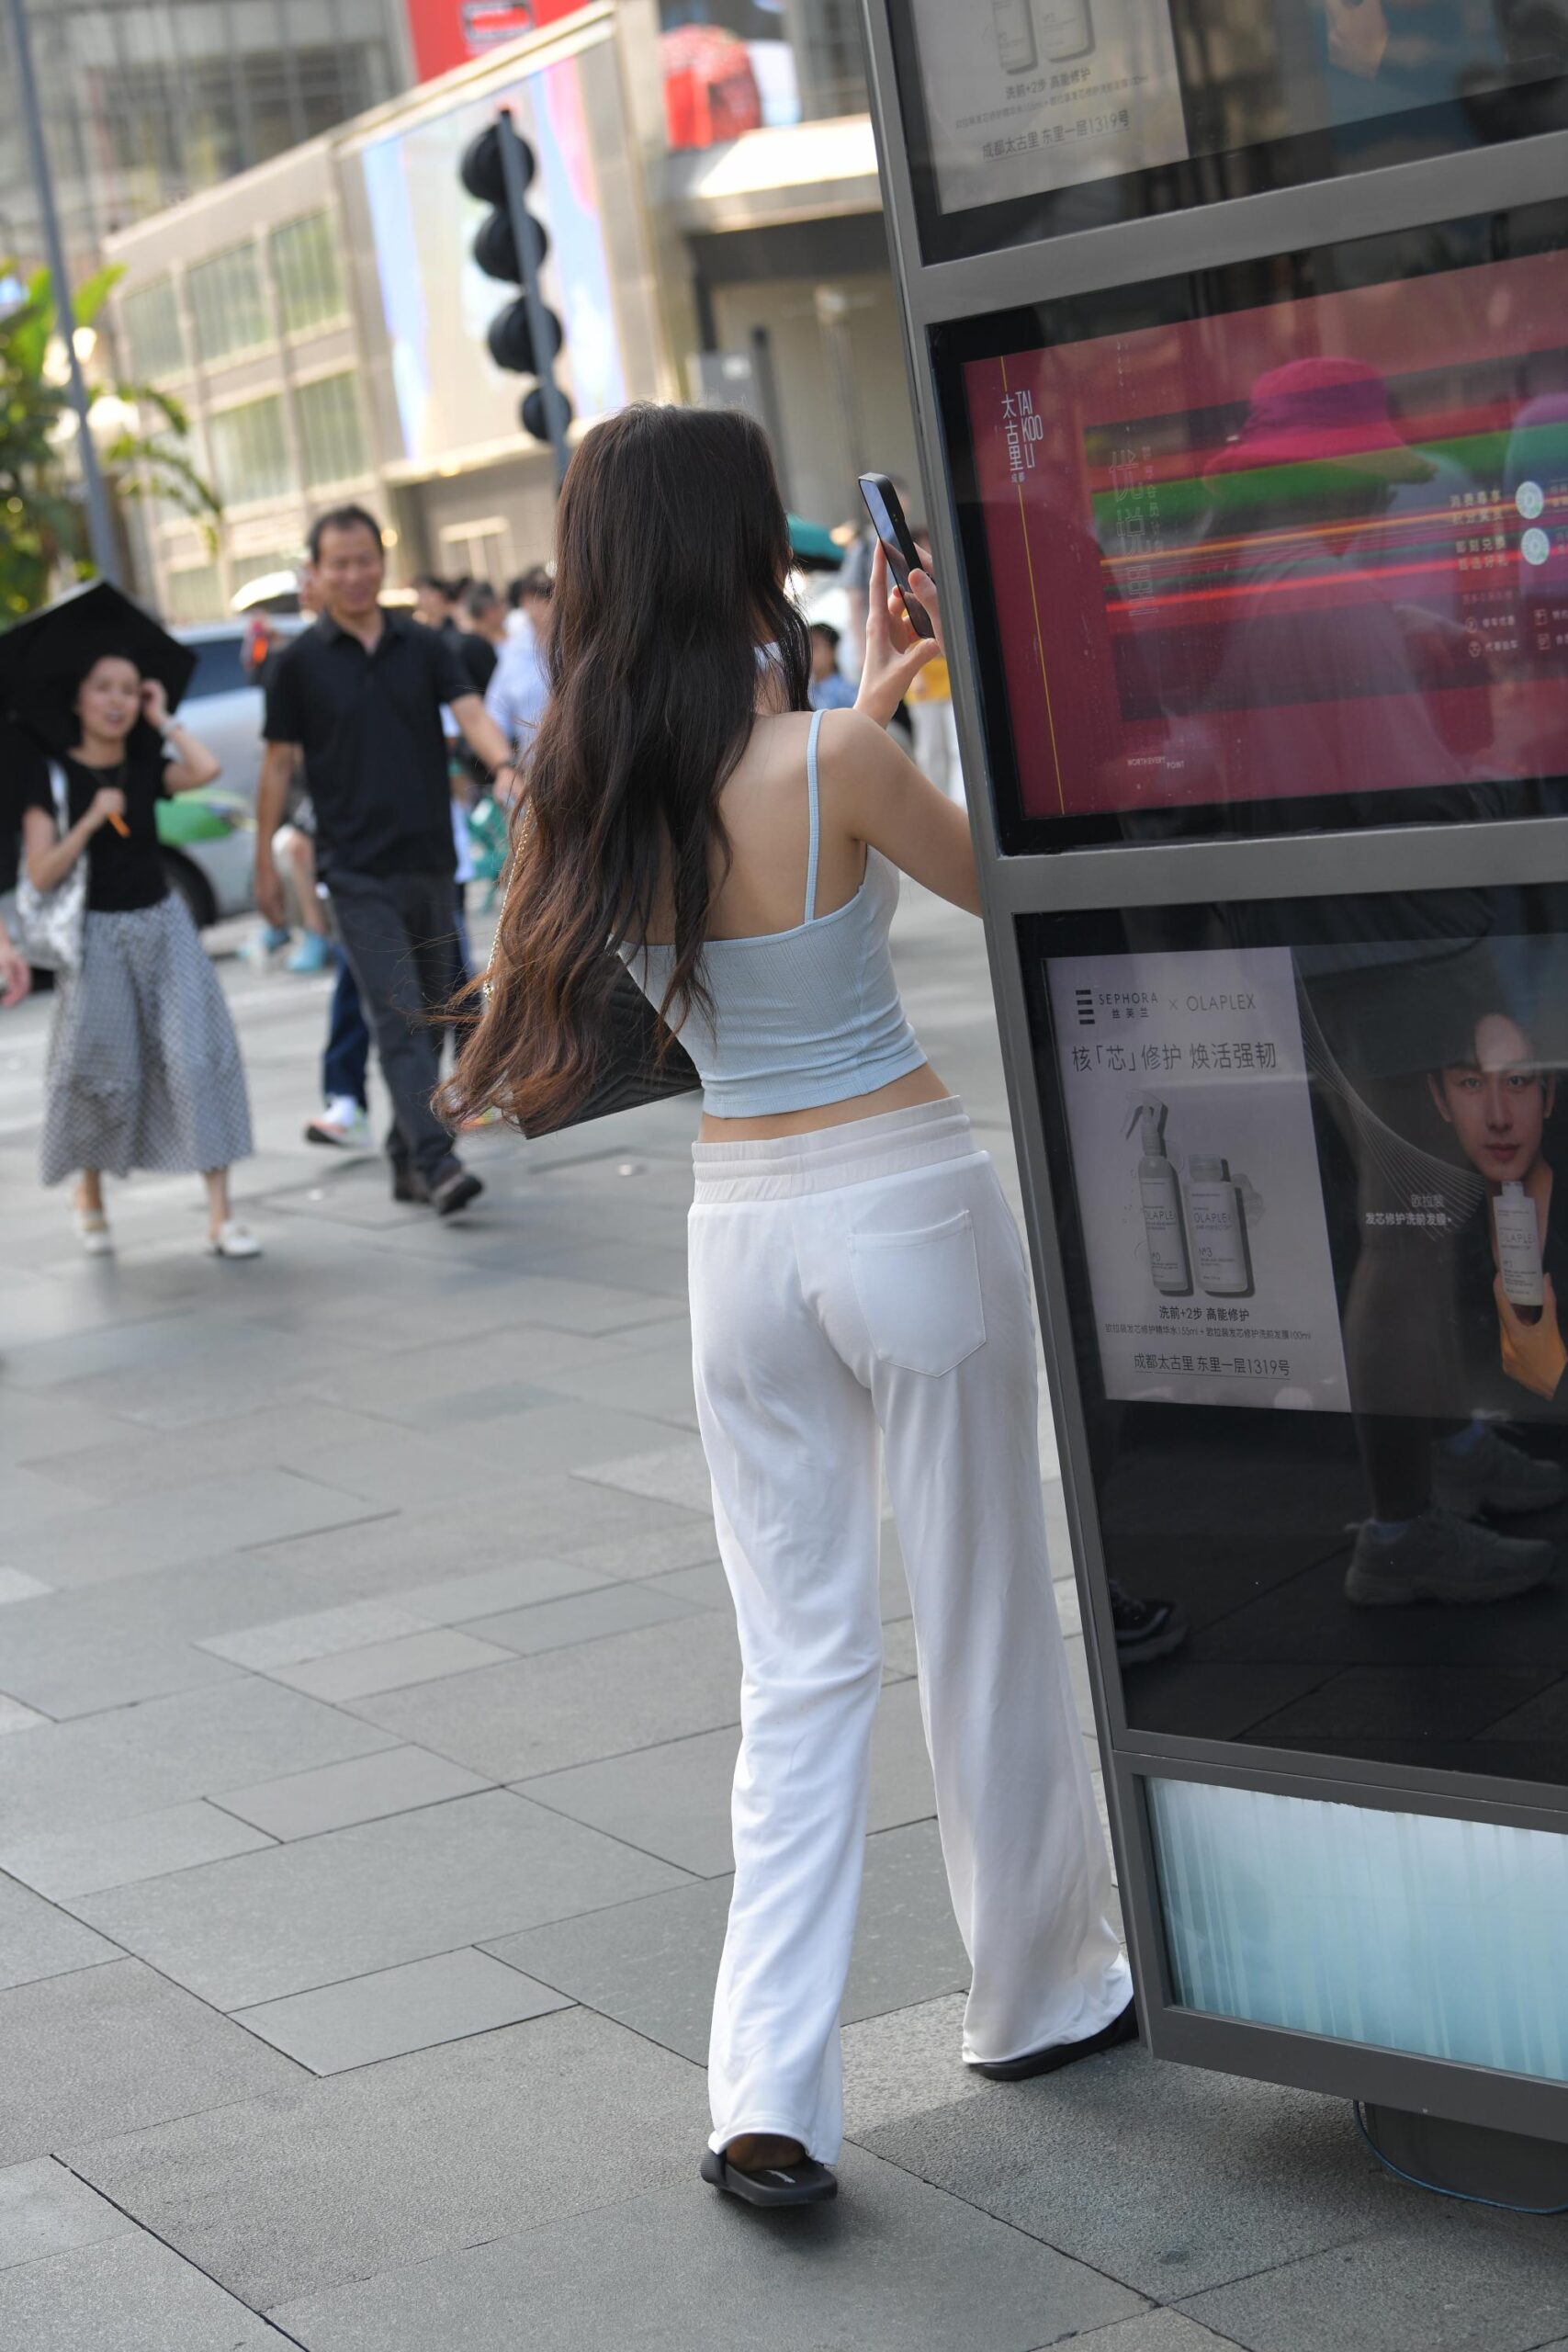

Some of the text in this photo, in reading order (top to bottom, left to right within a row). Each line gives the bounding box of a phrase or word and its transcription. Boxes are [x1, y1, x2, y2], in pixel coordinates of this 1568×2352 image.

[982, 131, 1038, 158] 成都太古里
[1042, 109, 1130, 144] 东里一层1319号
[1015, 390, 1033, 416] TAI
[1001, 394, 1023, 470] 太古里
[1021, 414, 1043, 442] KOO
[1024, 443, 1035, 469] LI
[1099, 992, 1158, 1005] SEPHORA
[1186, 994, 1256, 1012] OLAPLEX
[1111, 1007, 1149, 1019] 丝芙兰
[1072, 1042, 1277, 1072] 核「芯」修护 焕活强韧
[1159, 1306, 1250, 1322] 洗前+2步 高能修护
[1134, 1353, 1291, 1375] 成都太古里 东里一层1319号
